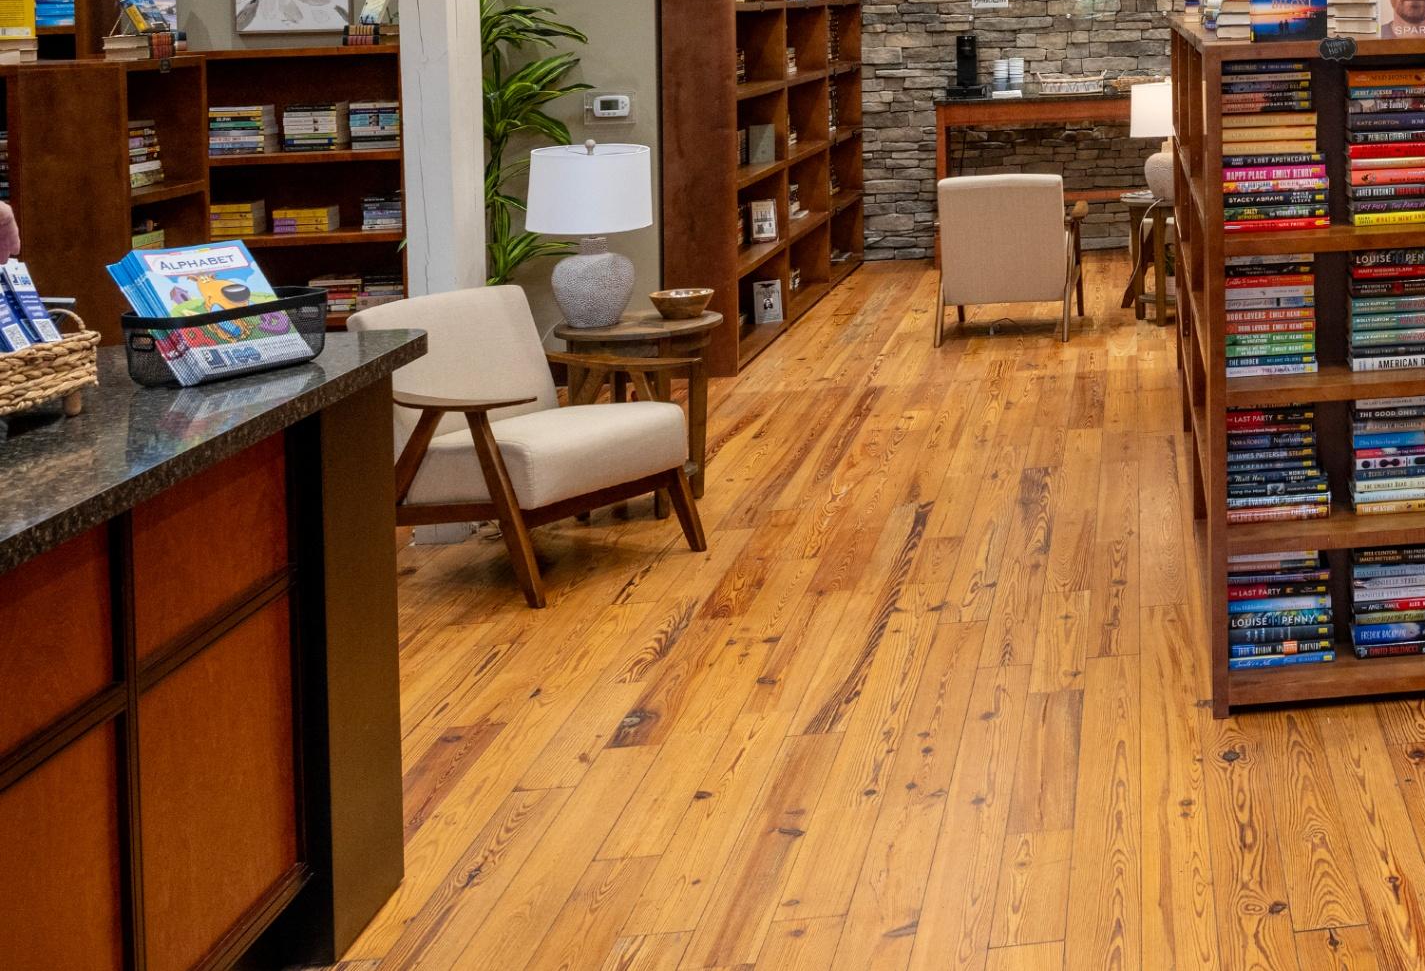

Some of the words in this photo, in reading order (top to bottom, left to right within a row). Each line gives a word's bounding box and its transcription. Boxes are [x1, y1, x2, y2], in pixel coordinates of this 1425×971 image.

[1389, 100, 1409, 110] Family
[1271, 155, 1311, 163] APOTHECARY
[1226, 171, 1246, 181] HAPPY
[1248, 170, 1267, 180] PLACE
[1272, 169, 1291, 179] EMILY
[1293, 168, 1312, 177] HENRY
[1373, 187, 1395, 196] KUSHNER
[160, 253, 235, 271] ALPHABET
[1356, 254, 1392, 264] LOUISE
[1244, 311, 1266, 320] LOVERS
[1378, 358, 1418, 369] AMERICAN
[1252, 414, 1273, 422] PARTY
[1239, 589, 1256, 597] LAST
[1258, 588, 1281, 596] PARTY
[1231, 617, 1267, 627] LOUISE
[1281, 615, 1315, 624] PENNY
